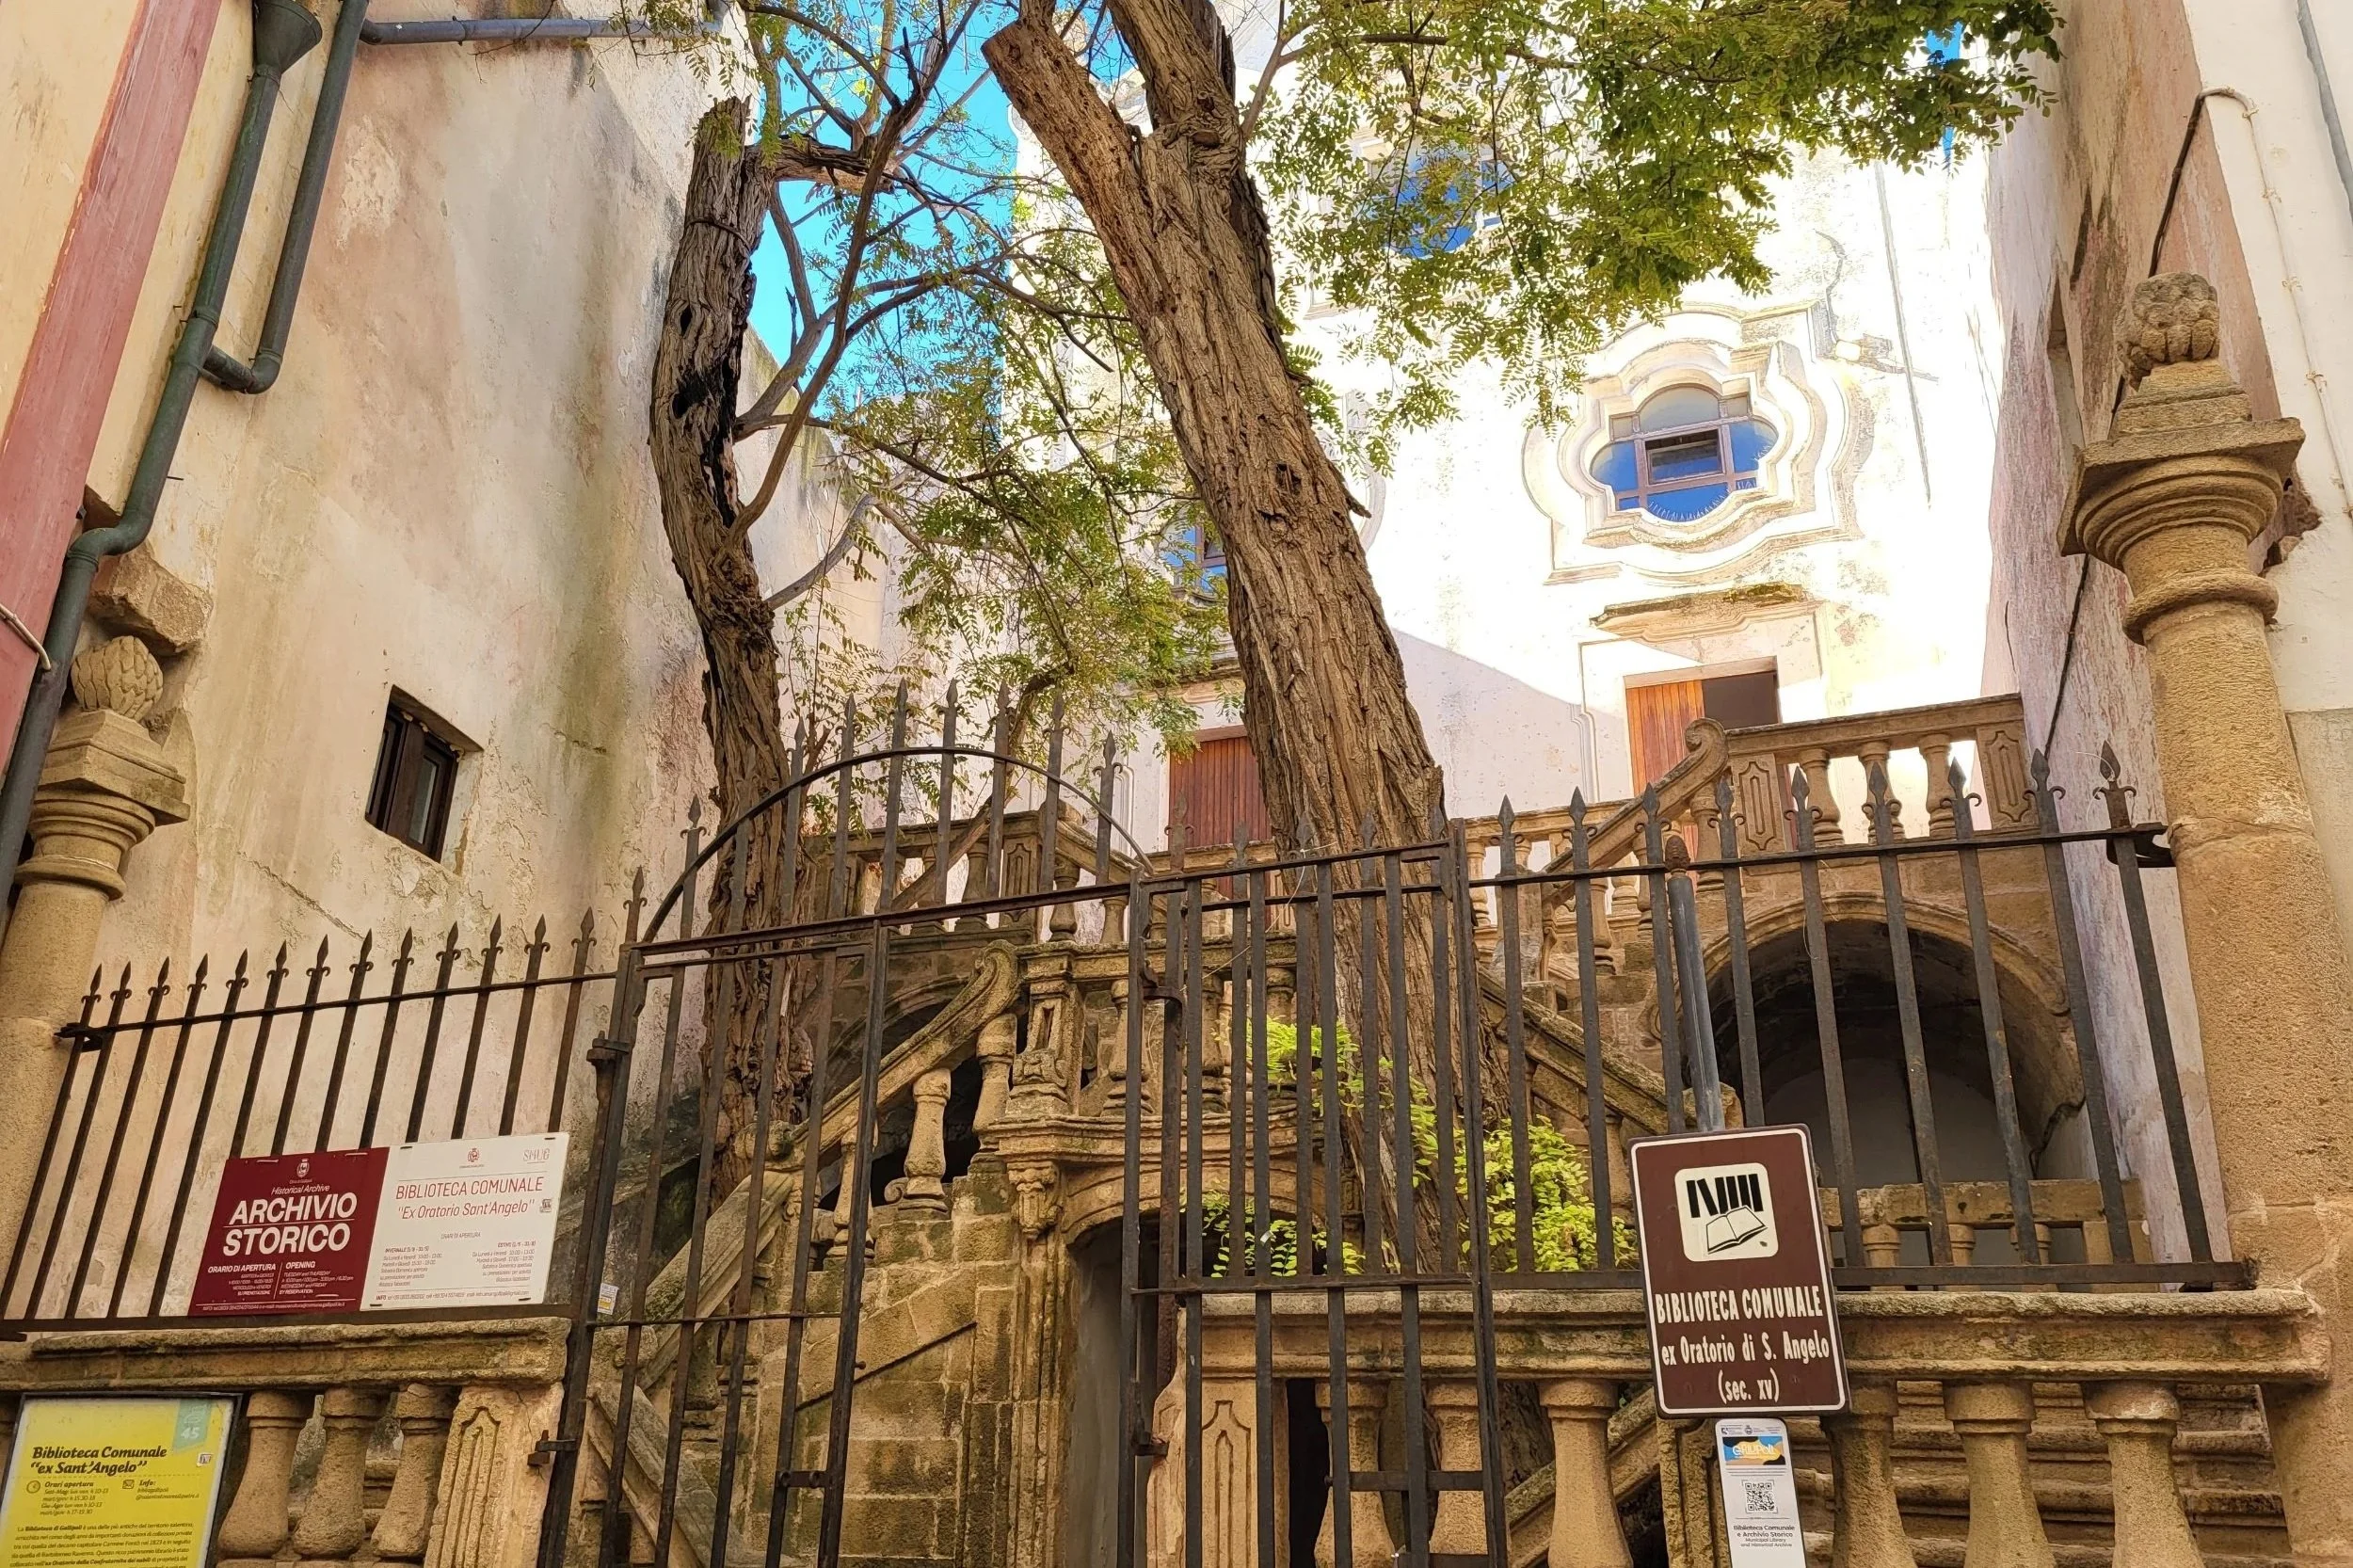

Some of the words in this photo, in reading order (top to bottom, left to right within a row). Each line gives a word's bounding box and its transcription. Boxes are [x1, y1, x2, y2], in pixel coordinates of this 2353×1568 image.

[271, 1185, 303, 1195] Historical
[303, 1184, 330, 1192] Archive
[395, 1181, 467, 1199] BIBLIOTECA
[471, 1176, 544, 1195] COMUNALE
[229, 1192, 358, 1225] ARCHIVIO
[418, 1201, 459, 1218] Oratorio
[222, 1224, 350, 1256] STORICO
[241, 1263, 277, 1272] APERTURA
[1655, 1289, 1739, 1323] BIBLIOTECA
[1741, 1286, 1823, 1320] COMUNALE
[1661, 1345, 1677, 1365] ex
[1680, 1335, 1736, 1365] Oratorio
[1741, 1333, 1756, 1361] di
[1762, 1332, 1777, 1361] S.
[1783, 1329, 1830, 1365] Angelo
[1719, 1369, 1753, 1404] (sec.
[181, 1427, 200, 1439] 45
[32, 1446, 99, 1459] Biblioteca
[102, 1446, 168, 1458] Comunale
